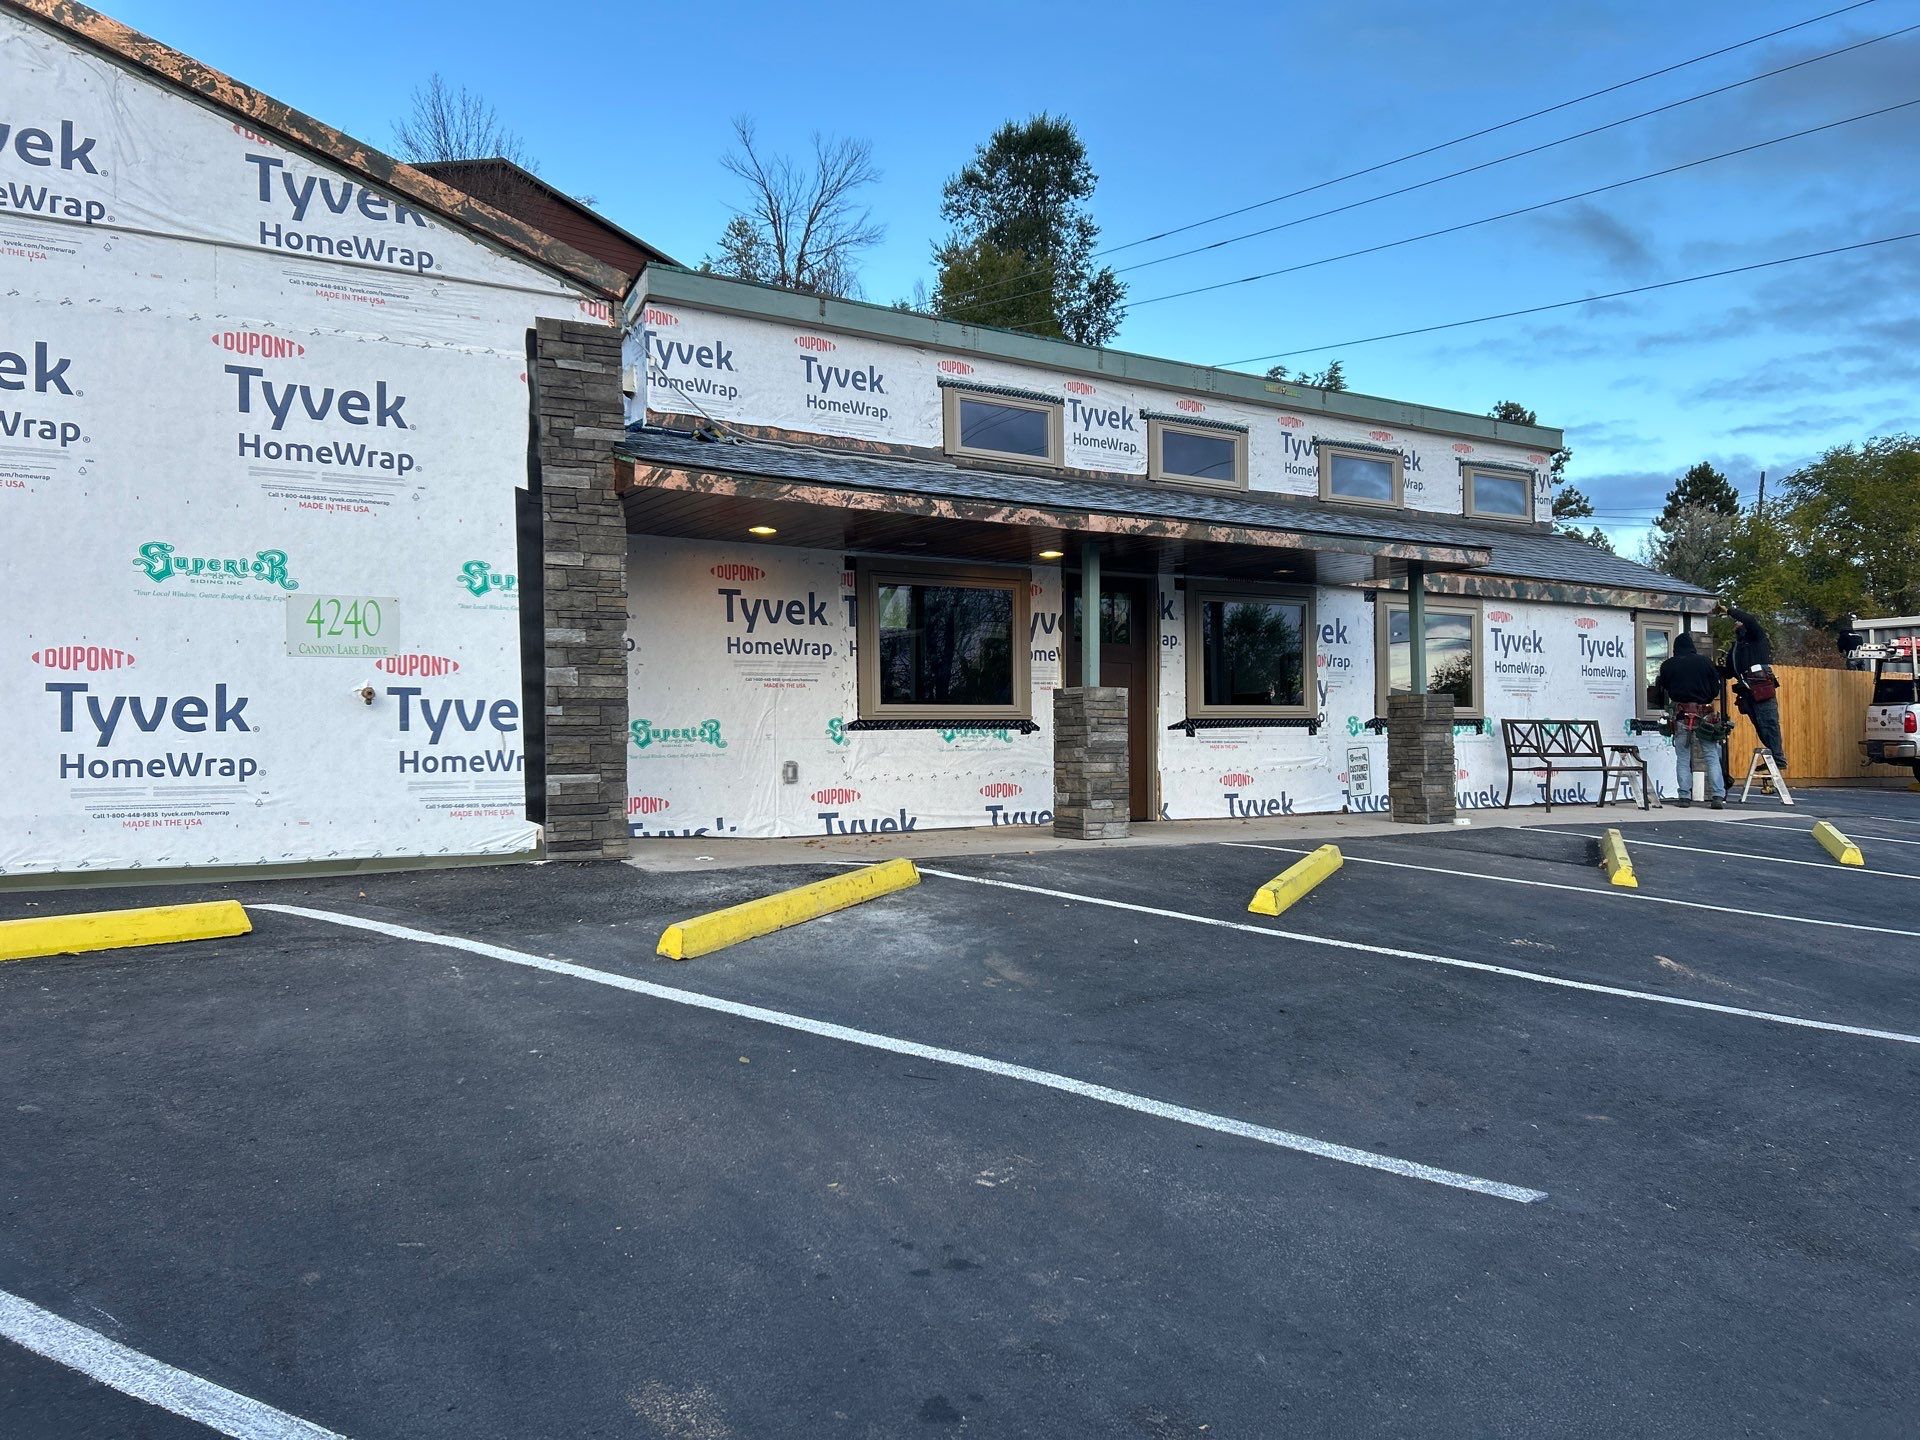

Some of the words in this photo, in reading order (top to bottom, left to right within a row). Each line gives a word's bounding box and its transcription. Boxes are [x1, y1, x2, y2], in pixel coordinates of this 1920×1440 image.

[4, 240, 76, 255] tyvek.com/homewrap
[7, 247, 25, 257] THE
[28, 250, 47, 260] USA
[260, 222, 434, 273] HomeWrap
[315, 289, 340, 299] MADE
[353, 294, 368, 303] THE
[370, 297, 386, 305] USA
[224, 331, 296, 358] DUPONT
[644, 330, 734, 371] Tyvek
[799, 336, 832, 352] DUPONT
[799, 354, 885, 394] Tyvek
[941, 360, 971, 376] DUPONT
[646, 371, 738, 401] HomeWrap
[1067, 382, 1093, 395] DUPONT
[224, 364, 408, 430] Tyvek
[806, 394, 889, 421] HomeWrap
[1067, 398, 1134, 431] Tyvek
[1179, 400, 1204, 413] DUPONT
[1073, 432, 1137, 455] HomeWrap
[238, 432, 415, 476] HomeWrap
[5, 480, 25, 488] USA
[299, 501, 324, 510] MADE
[325, 503, 334, 511] IN
[336, 504, 352, 512] THE
[353, 505, 370, 513] USA
[717, 564, 760, 581] DUPONT
[190, 578, 225, 586] SIDING
[221, 592, 244, 601] Roofing
[305, 598, 382, 639] 4240
[718, 588, 829, 633] Tyvek
[727, 637, 833, 659] HomeWrap
[1491, 628, 1543, 658] Tyvek
[1578, 633, 1624, 662] Tyvek
[44, 646, 125, 671] DUPONT
[386, 655, 451, 676] DUPONT
[1495, 661, 1545, 677] HomeWrap
[1581, 665, 1627, 680] HomeWrap
[45, 682, 251, 747] Tyvek
[60, 752, 258, 782] HomeWrap
[1223, 773, 1250, 788] DUPONT
[817, 788, 856, 805] DUPONT
[984, 783, 1018, 798] DUPONT
[106, 811, 159, 819] 1-800-448-9835
[161, 810, 230, 819] tyvek.com/homewrap
[450, 810, 473, 818] MADE
[484, 809, 499, 817] THE
[500, 809, 515, 817] USA
[122, 819, 151, 828] MADE
[152, 819, 163, 828] IN
[164, 818, 182, 827] THE
[184, 818, 203, 827] USA
